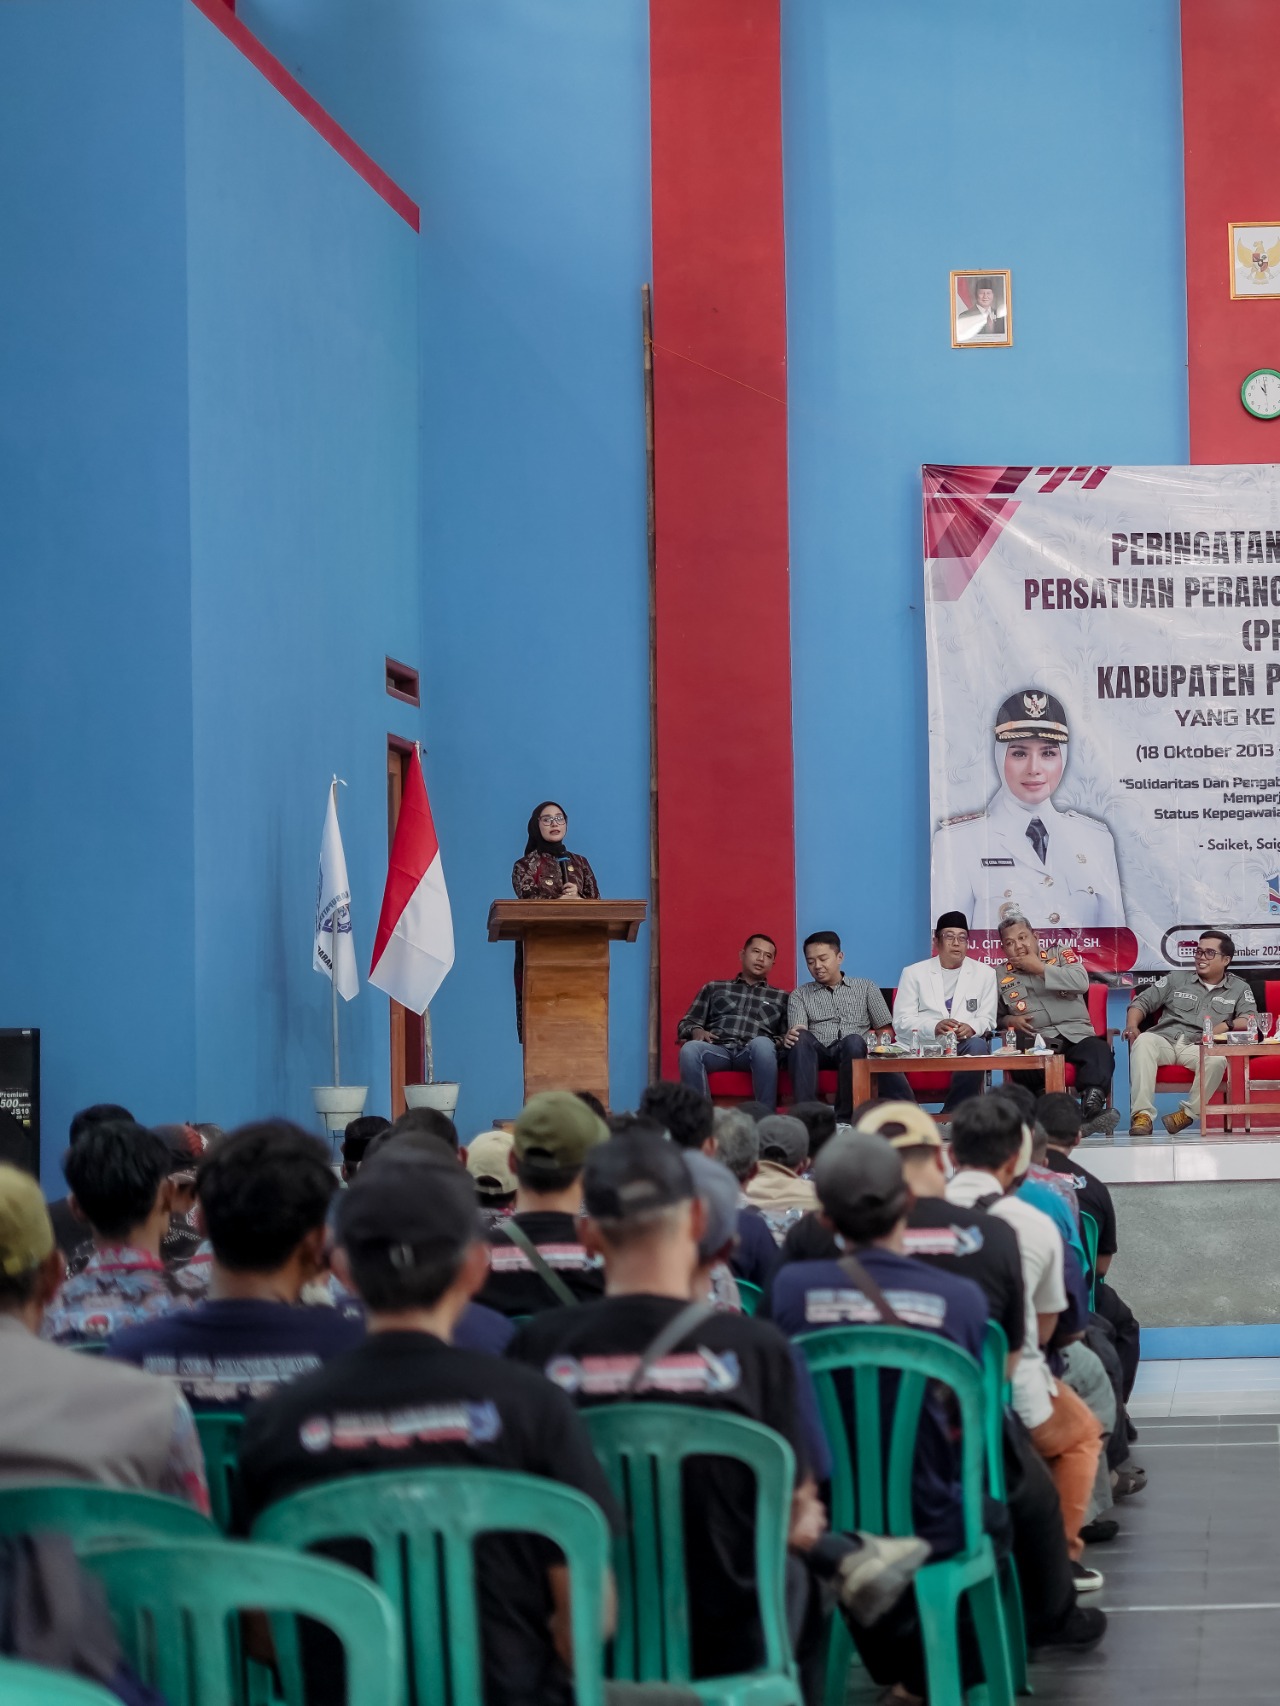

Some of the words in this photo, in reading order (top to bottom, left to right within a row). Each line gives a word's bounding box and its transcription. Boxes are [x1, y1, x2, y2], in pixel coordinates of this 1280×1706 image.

[1024, 577, 1174, 610] PERSATUAN
[1097, 663, 1255, 699] KABUPATEN
[1174, 708, 1239, 727] YANG
[1246, 707, 1275, 726] KE
[1136, 744, 1159, 762] (18
[1164, 745, 1232, 759] Oktober
[1236, 743, 1274, 757] 2013
[1203, 777, 1229, 789] Dan
[1154, 808, 1200, 820] Status
[1207, 838, 1253, 851] Saiket,
[982, 939, 1003, 950] CIT
[1038, 938, 1080, 951] RIYAMI,
[1083, 937, 1101, 948] SH.
[1233, 946, 1260, 957] ember
